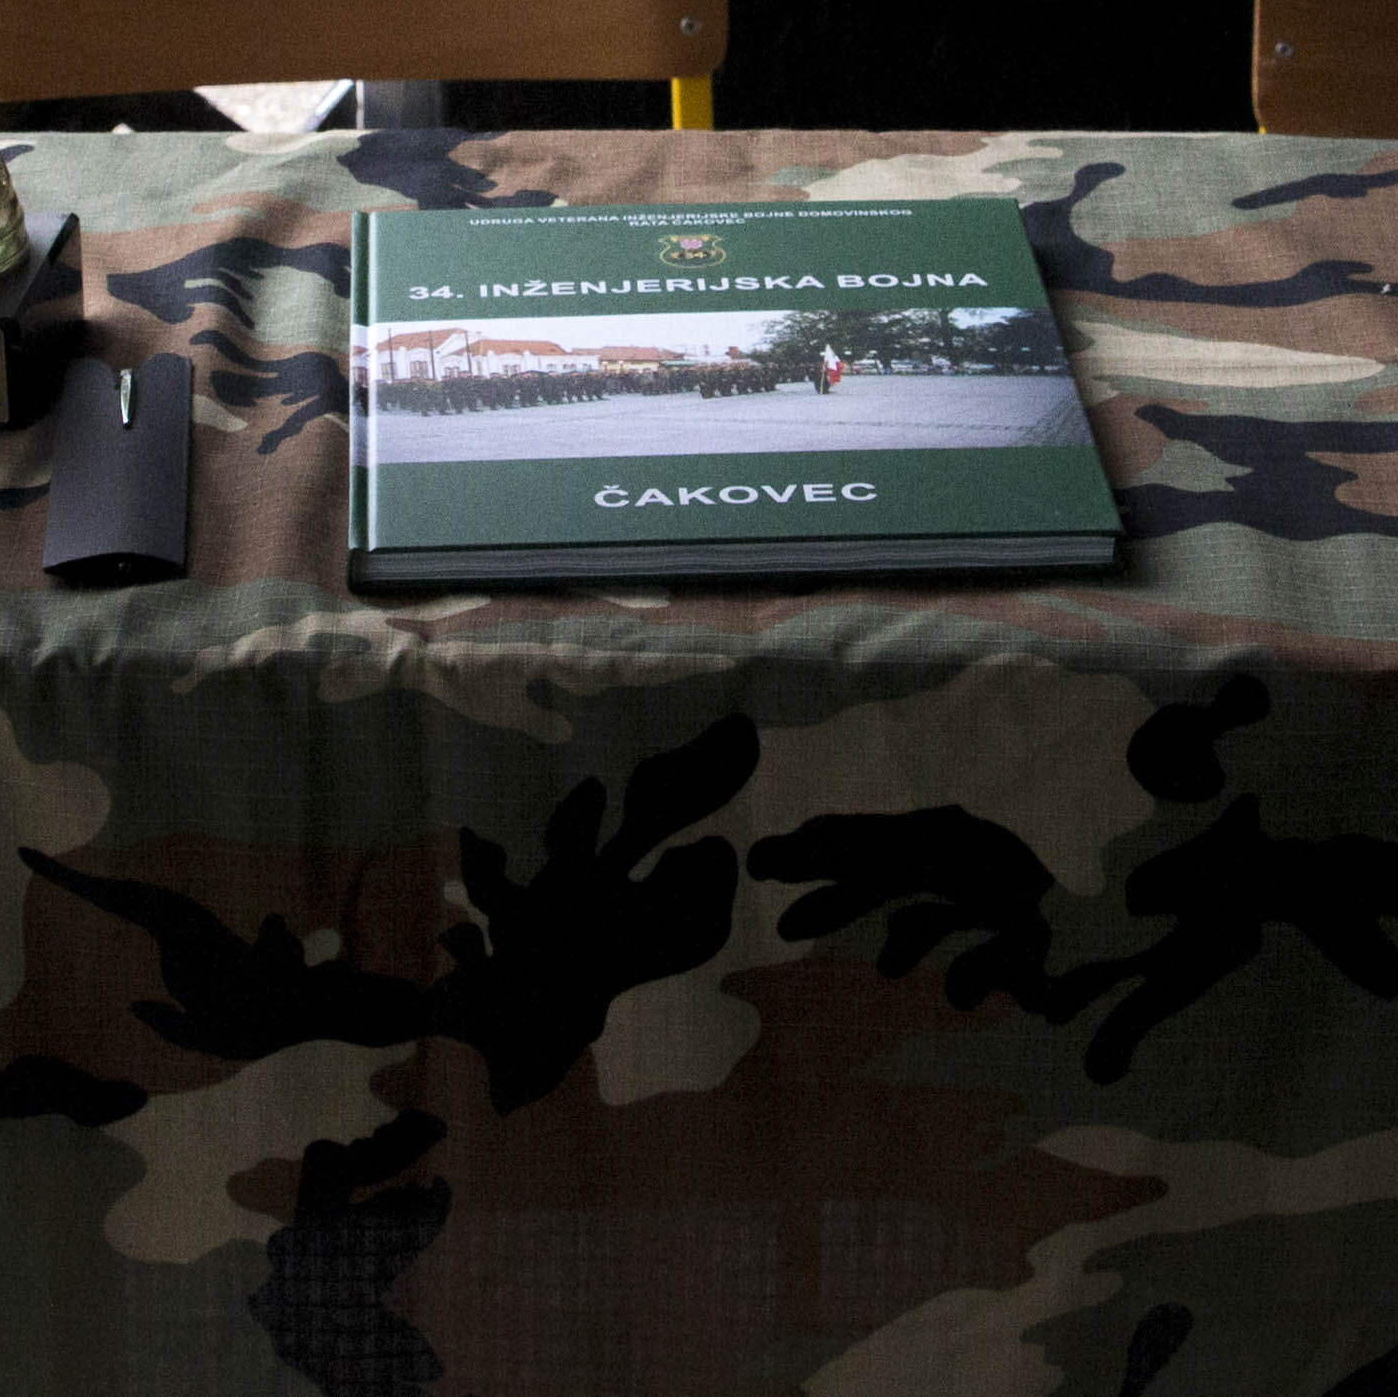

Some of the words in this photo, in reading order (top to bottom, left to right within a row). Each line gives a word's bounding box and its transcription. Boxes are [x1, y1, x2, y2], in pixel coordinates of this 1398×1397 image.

[469, 218, 534, 226] UDRUGA
[538, 215, 620, 224] VETERANA
[744, 211, 794, 219] BOJNE
[798, 208, 913, 218] DOMOVINSKOG
[629, 219, 668, 227] RATA
[672, 216, 745, 226] ČAKOVEC
[409, 285, 464, 300] 34.
[480, 275, 825, 298] INŽENJERIJSKA
[836, 273, 988, 289] BOJNA
[594, 482, 878, 508] ČAKOVEC
